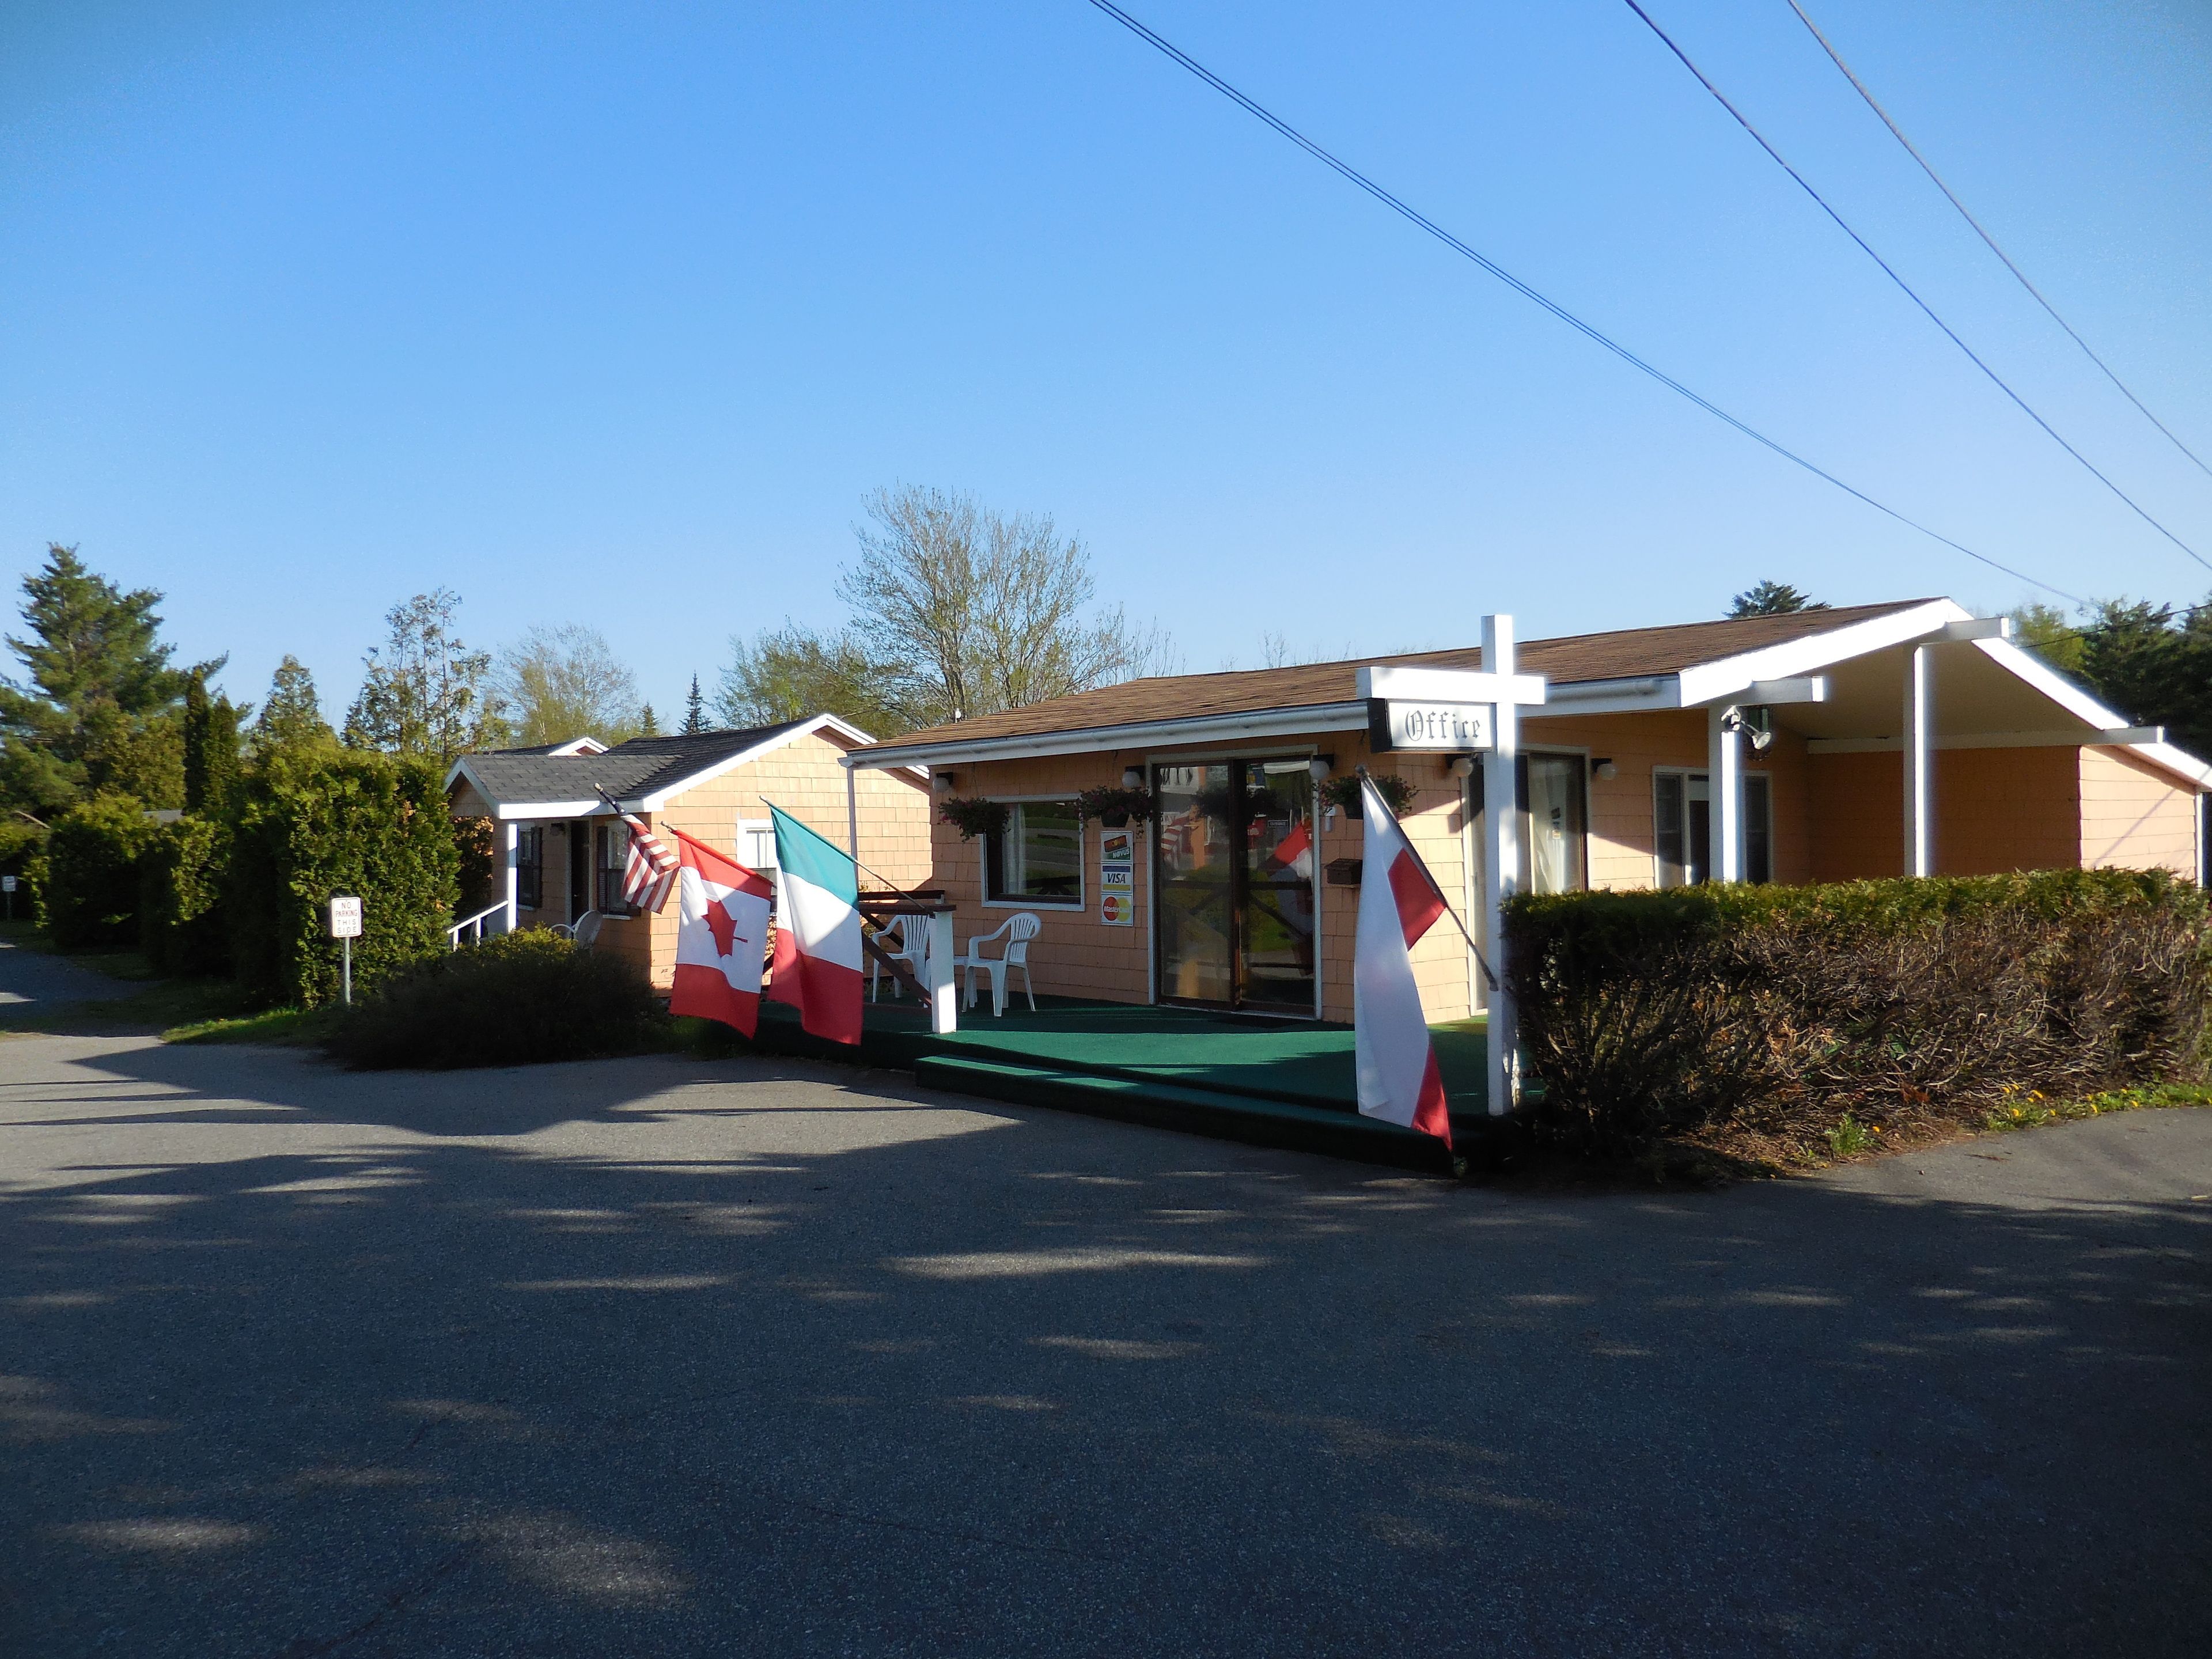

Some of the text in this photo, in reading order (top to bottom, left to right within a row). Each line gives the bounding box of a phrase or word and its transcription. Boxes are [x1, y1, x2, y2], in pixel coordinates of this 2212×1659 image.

[1404, 710, 1480, 741] Office
[1112, 848, 1130, 858] NOVUS
[1107, 873, 1126, 884] VISA
